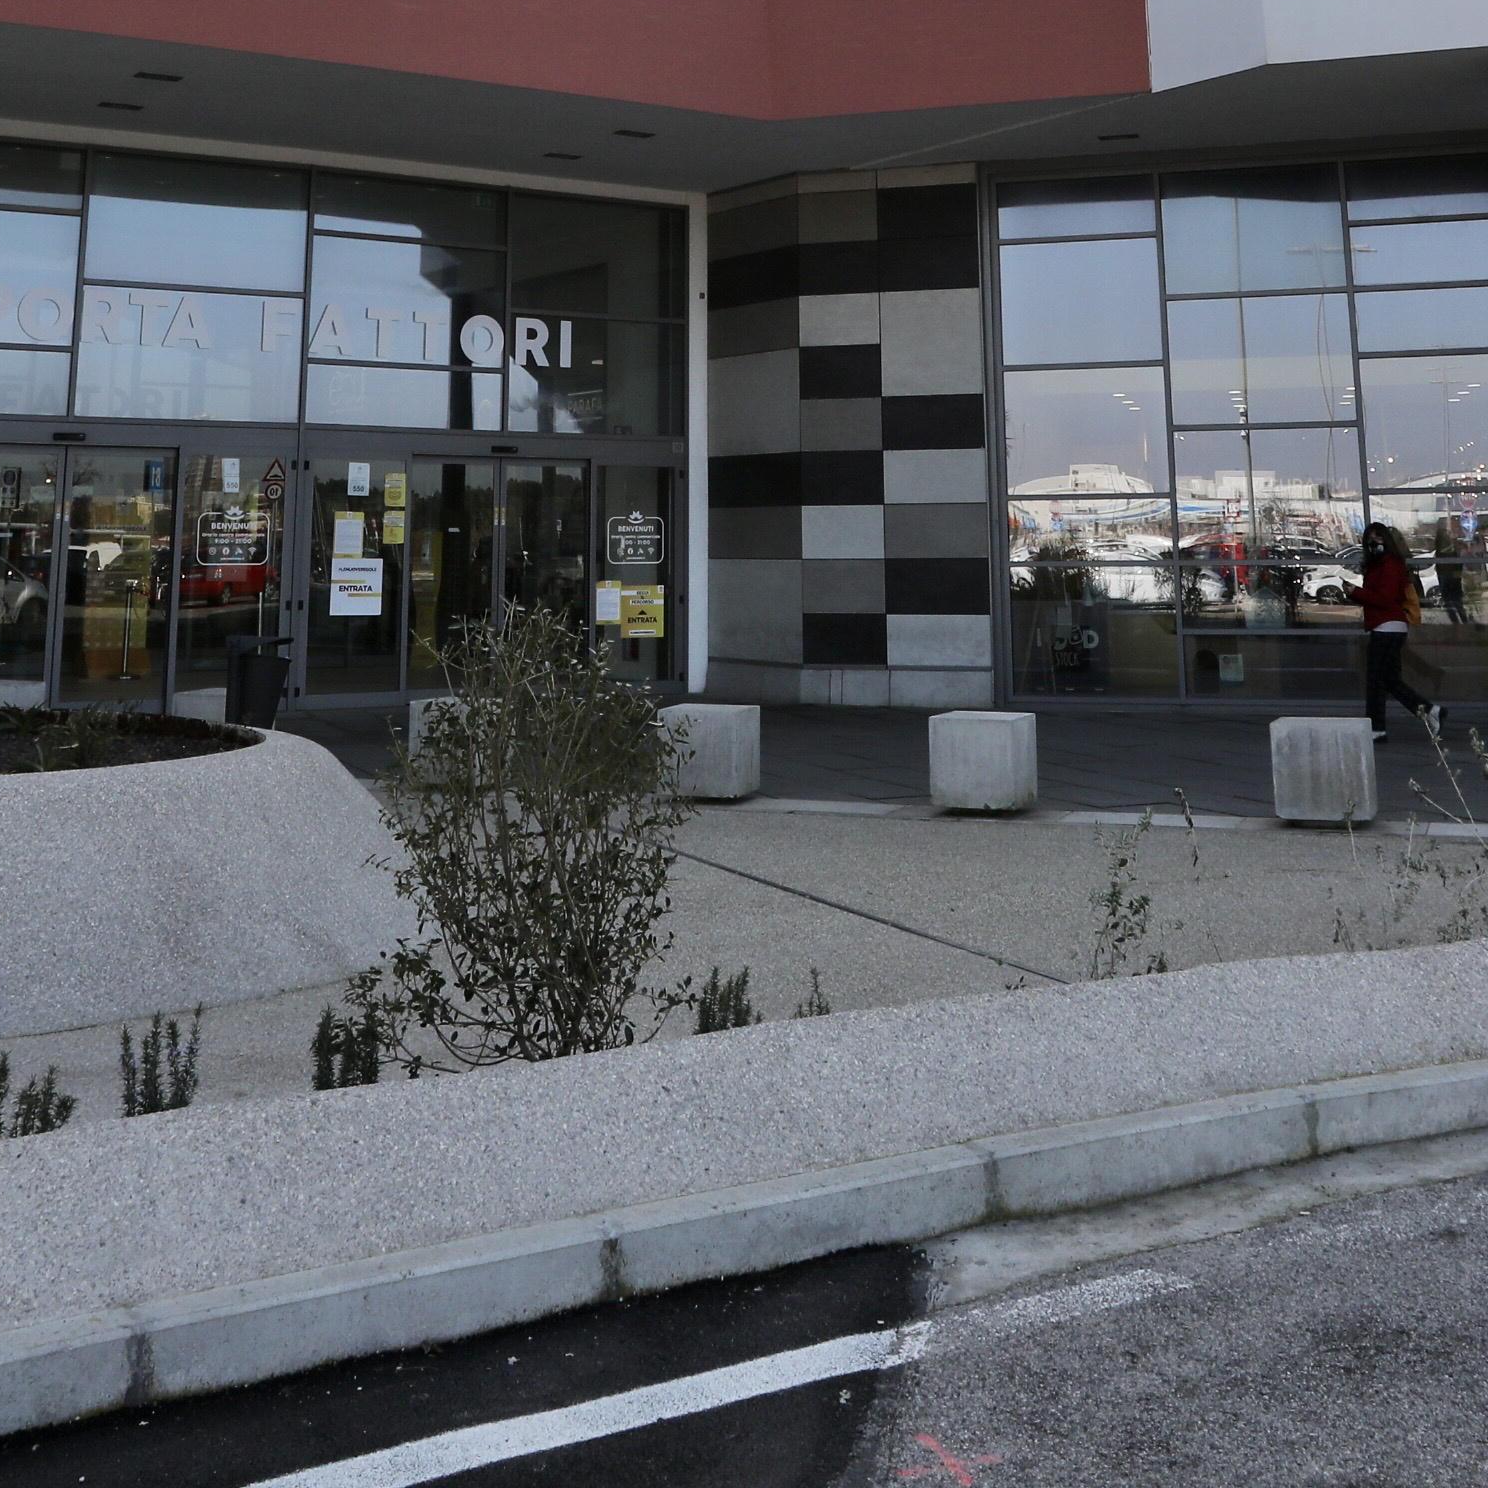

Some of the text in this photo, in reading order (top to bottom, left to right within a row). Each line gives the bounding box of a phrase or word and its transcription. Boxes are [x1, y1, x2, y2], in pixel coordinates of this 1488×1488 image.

[261, 299, 573, 369] FATTORI
[617, 525, 655, 533] BENVENUTI
[338, 584, 373, 592] ENTRATA
